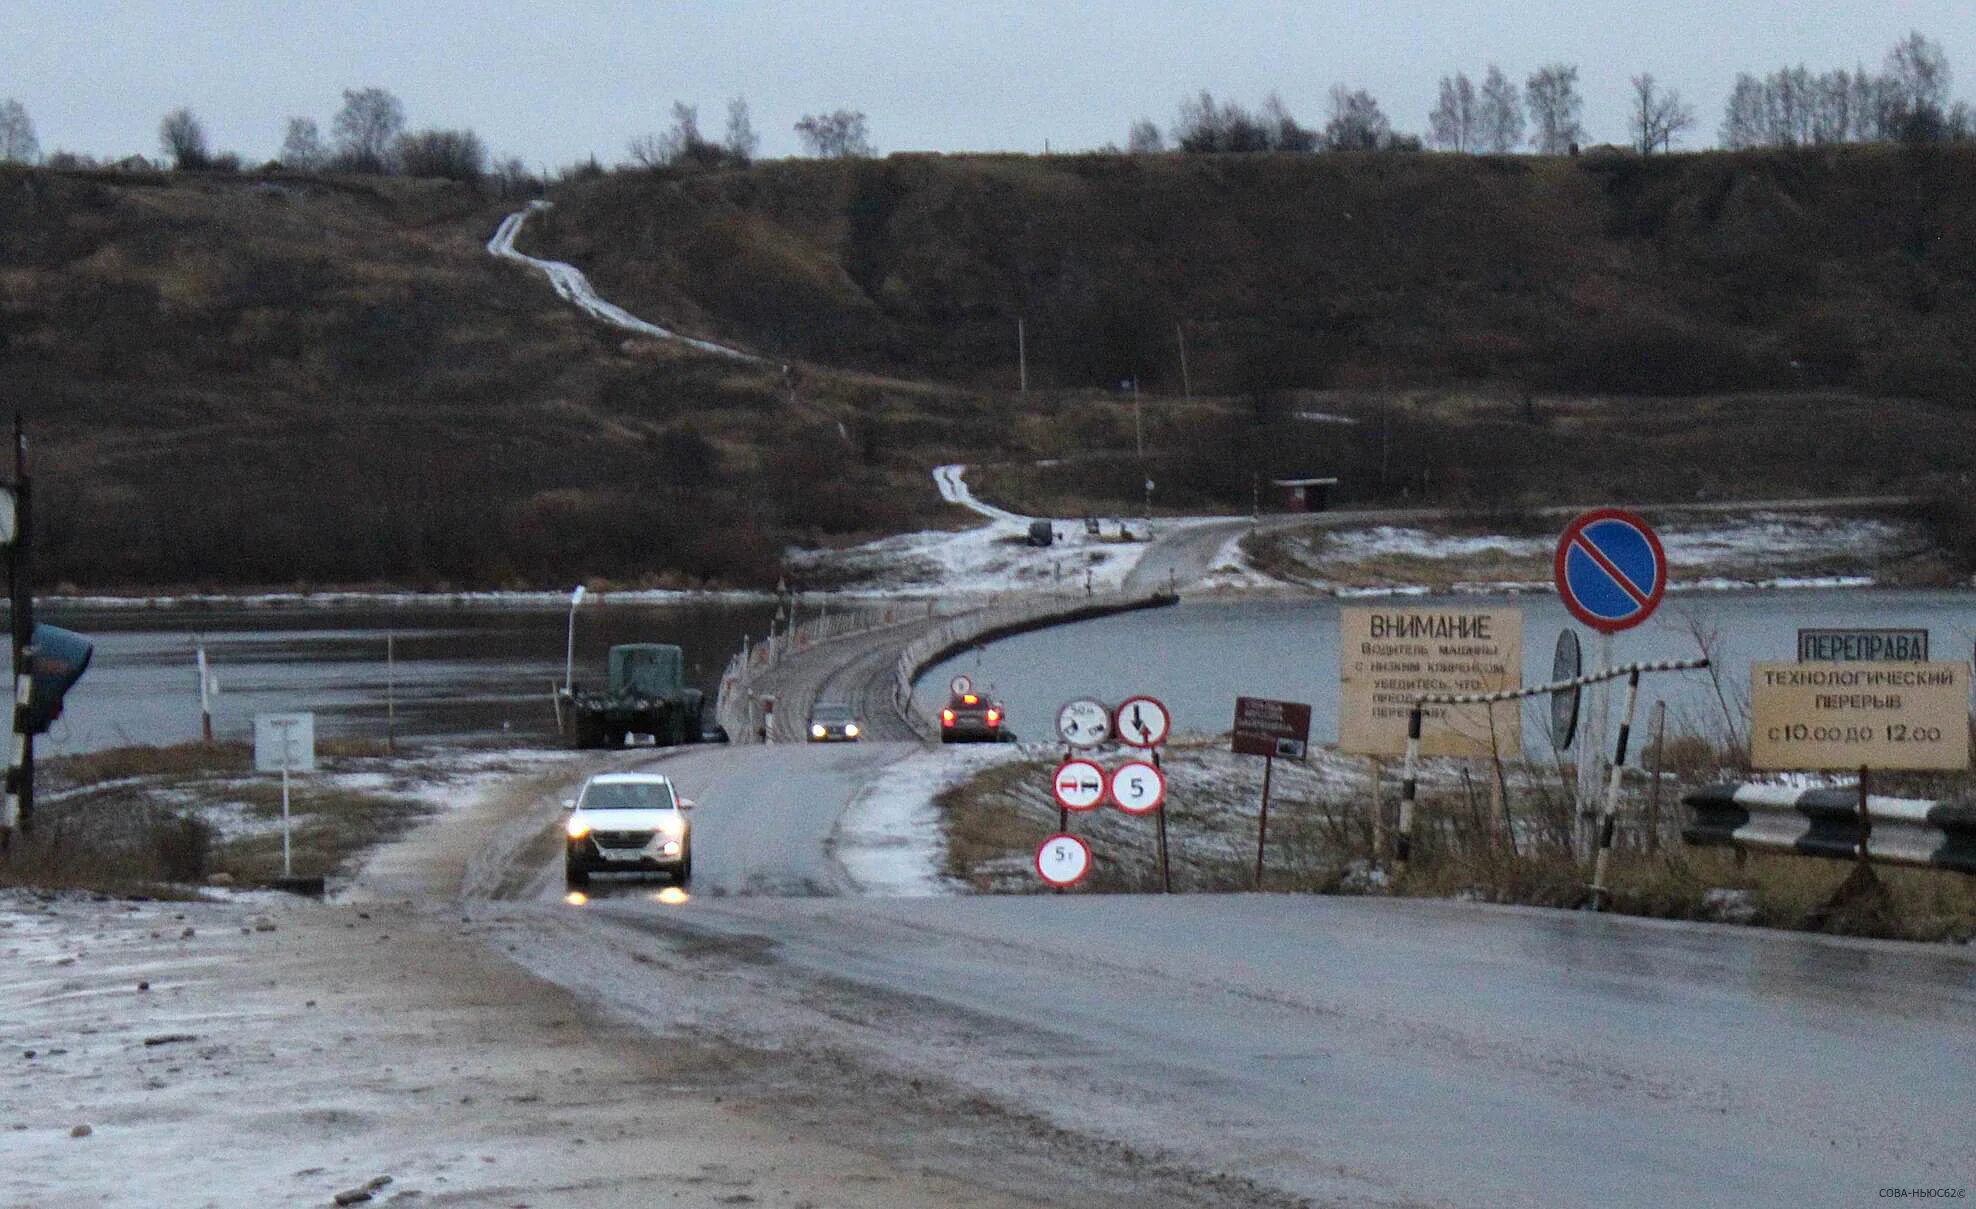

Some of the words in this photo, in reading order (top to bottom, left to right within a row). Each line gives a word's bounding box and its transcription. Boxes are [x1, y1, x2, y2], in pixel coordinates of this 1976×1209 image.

[1370, 615, 1492, 639] ВНИМАНИЕ
[1804, 635, 1922, 660] ПЕРЕПРАВА
[1764, 667, 1954, 687] ТЕХНОЛОГИЧЕСКИЙ
[1814, 694, 1902, 710] ПЕРЕРЫВ
[1886, 723, 1942, 742] 12.00
[1130, 778, 1145, 799] 5
